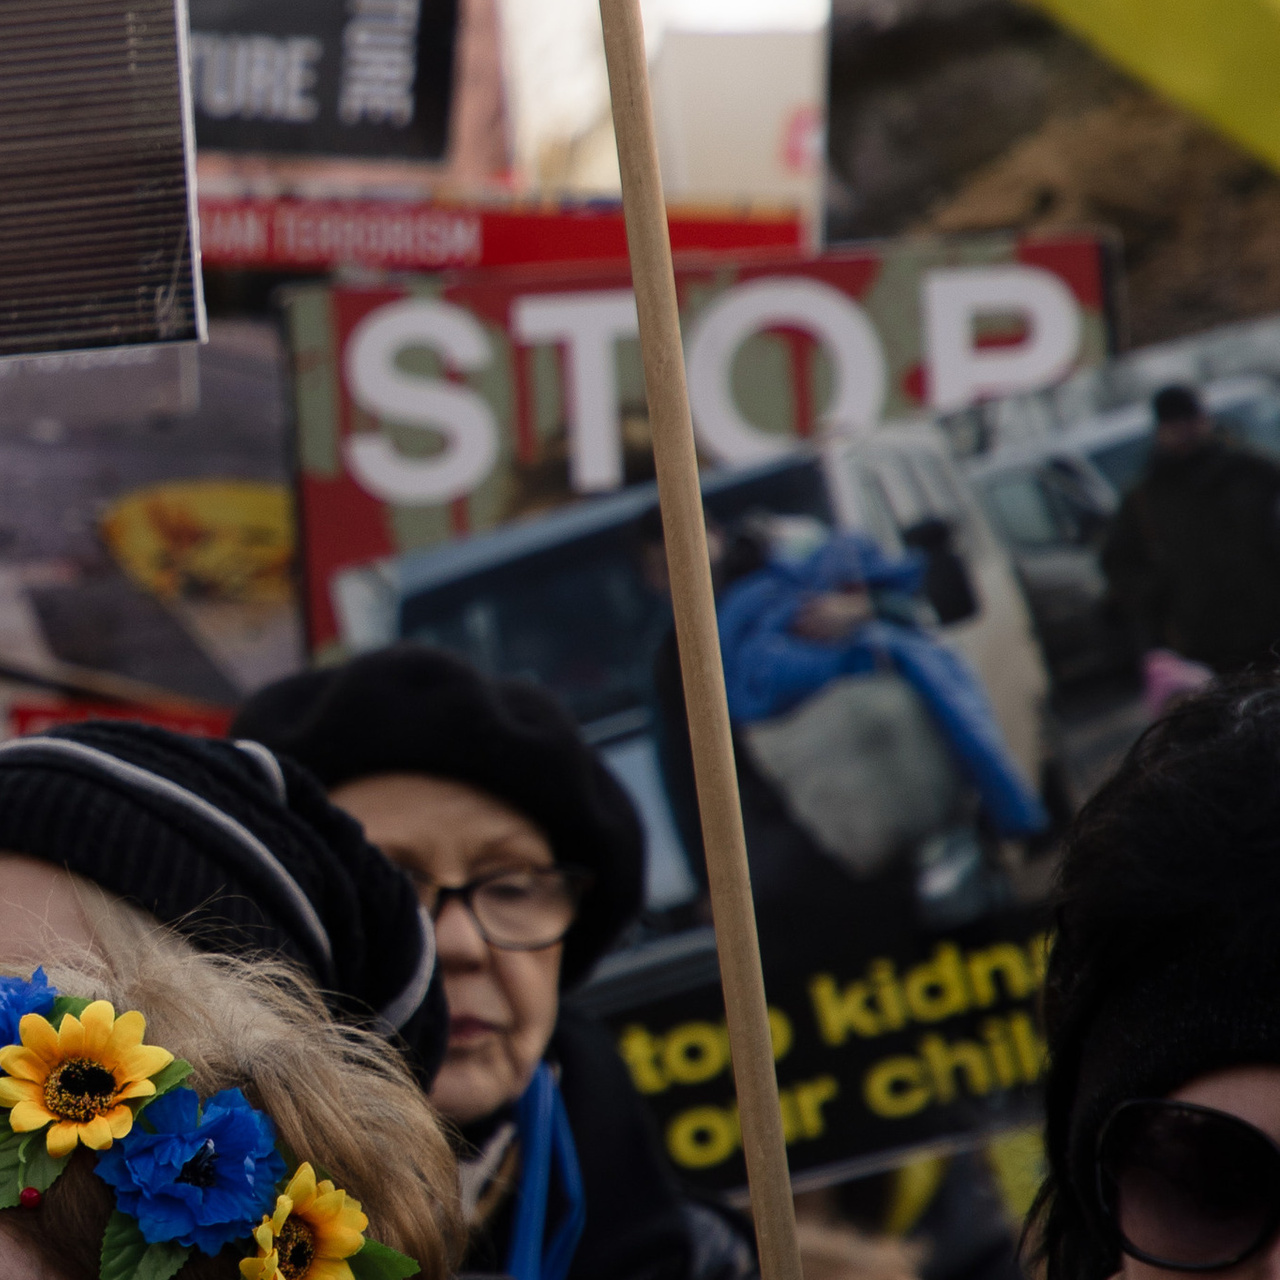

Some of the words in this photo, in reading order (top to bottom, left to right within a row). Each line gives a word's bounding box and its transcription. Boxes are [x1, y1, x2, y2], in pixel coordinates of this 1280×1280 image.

[344, 264, 1082, 505] STOP
[806, 929, 1055, 1047] kidn
[666, 1074, 838, 1169] or
[863, 1011, 1048, 1119] chil
